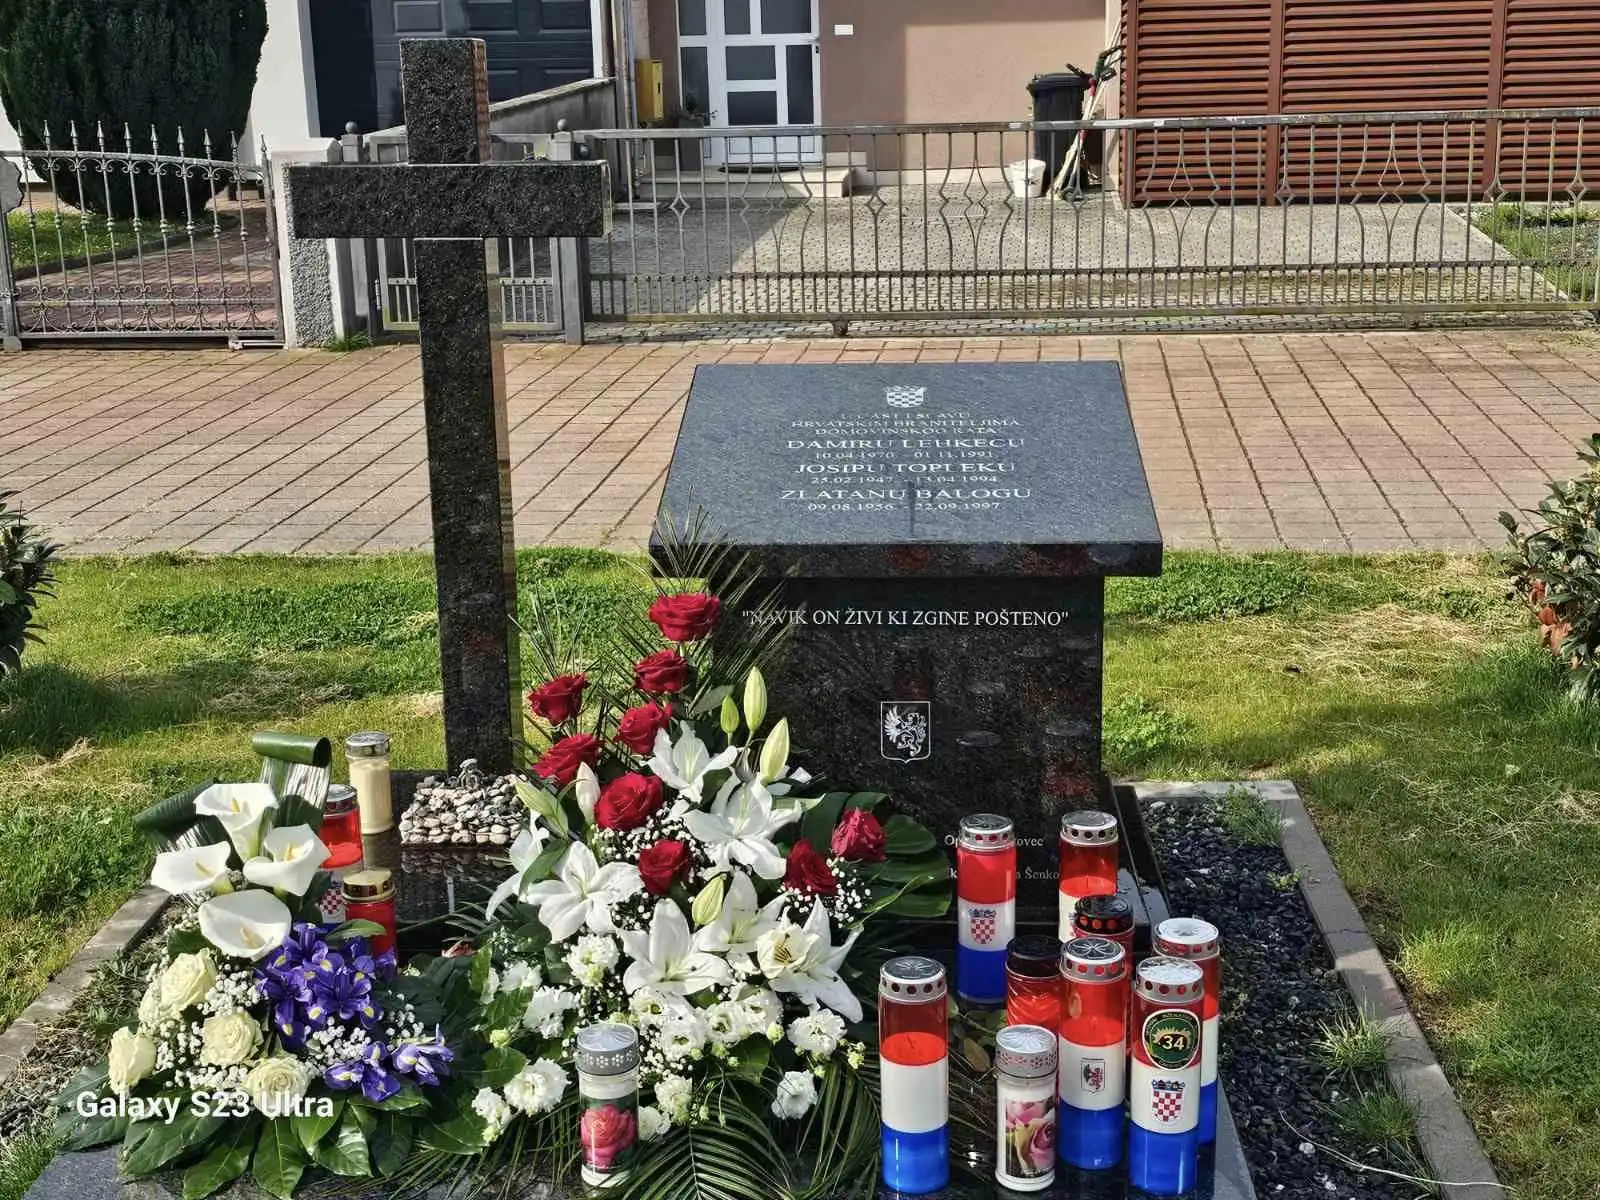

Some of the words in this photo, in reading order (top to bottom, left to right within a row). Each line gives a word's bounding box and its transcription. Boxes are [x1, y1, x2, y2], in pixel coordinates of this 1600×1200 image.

[788, 440, 897, 449] DAMIRU
[794, 464, 887, 473] JOSIPU
[893, 463, 1016, 473] TOPLEKU
[780, 490, 906, 500] ZLATANU
[915, 488, 1032, 499] BALOGU
[812, 609, 840, 625] ON
[844, 606, 882, 625] ŽIVI
[887, 610, 907, 625] KI
[912, 610, 969, 626] ZGINE
[1162, 1035, 1185, 1051] 34
